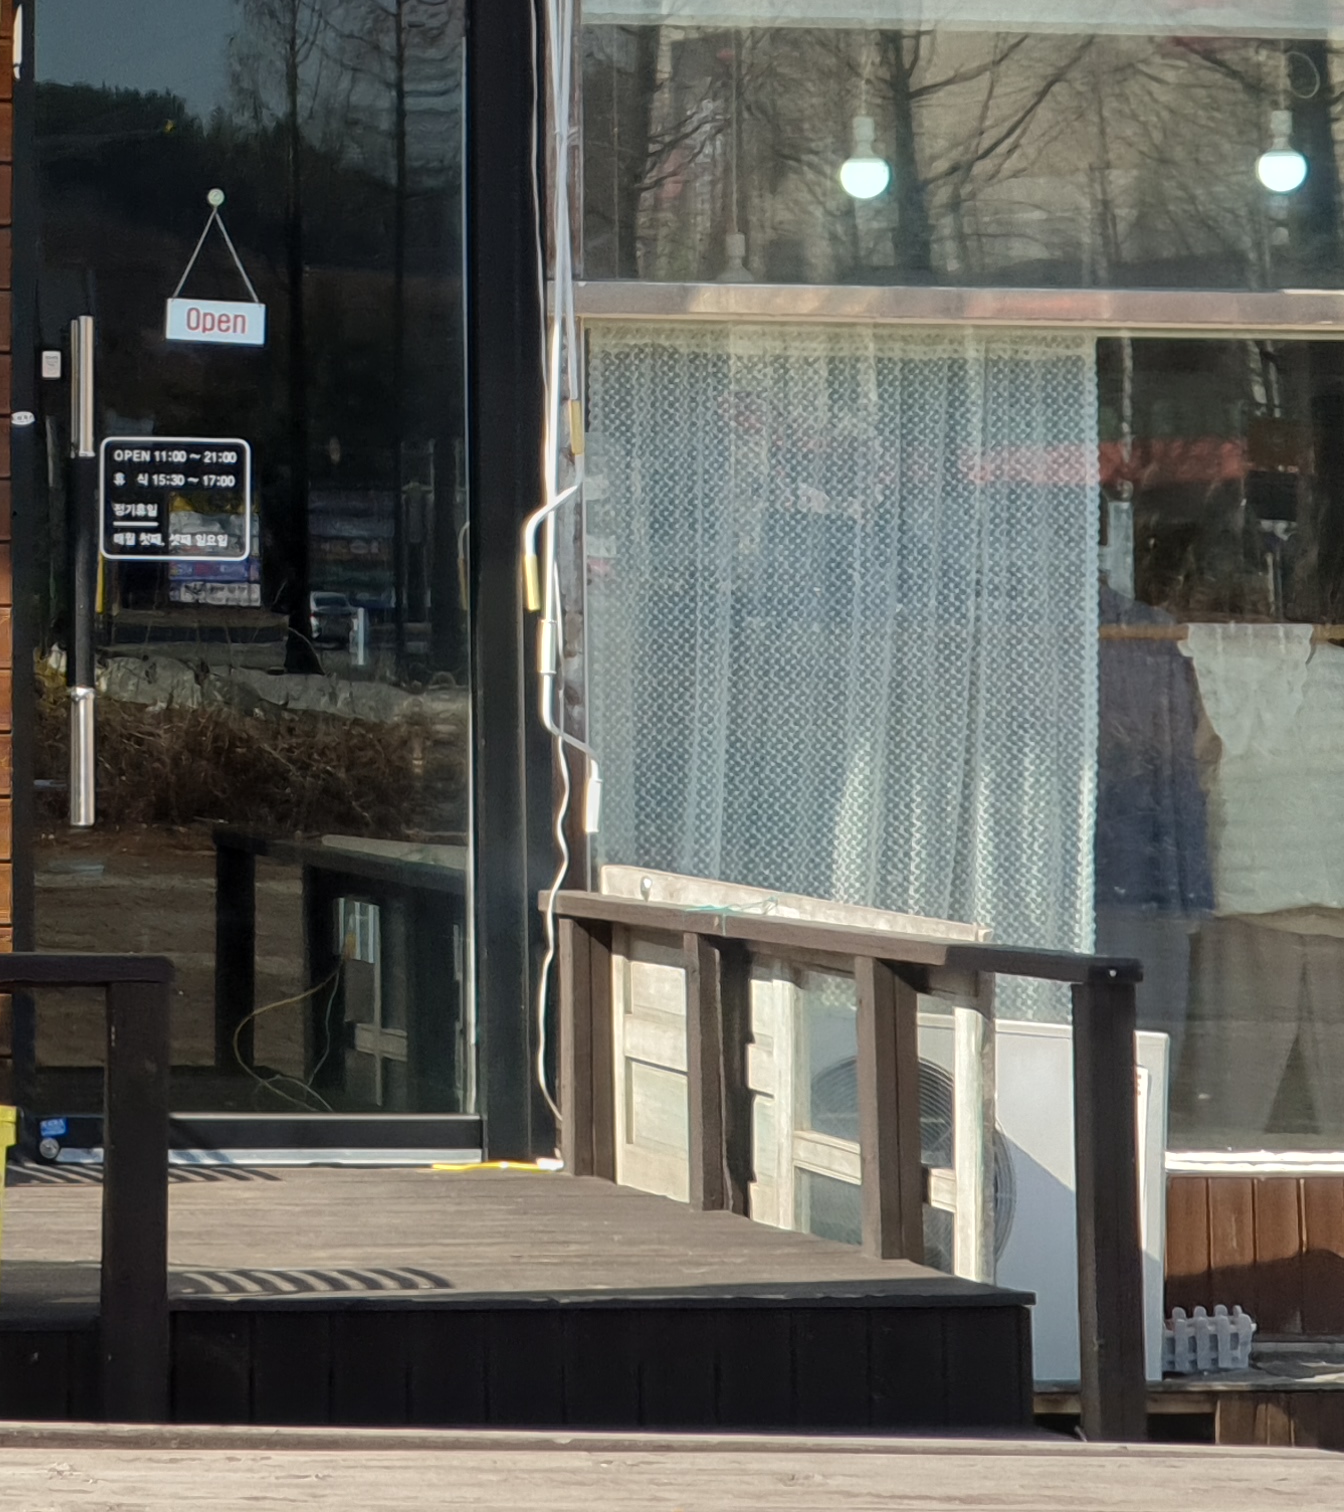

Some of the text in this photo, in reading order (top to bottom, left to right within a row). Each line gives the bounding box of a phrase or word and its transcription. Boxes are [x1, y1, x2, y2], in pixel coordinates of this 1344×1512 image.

[185, 306, 247, 335] Open
[113, 449, 151, 462] OPEN
[203, 451, 238, 463] 21:00
[151, 473, 185, 486] 15:30
[202, 474, 236, 487] 17:00
